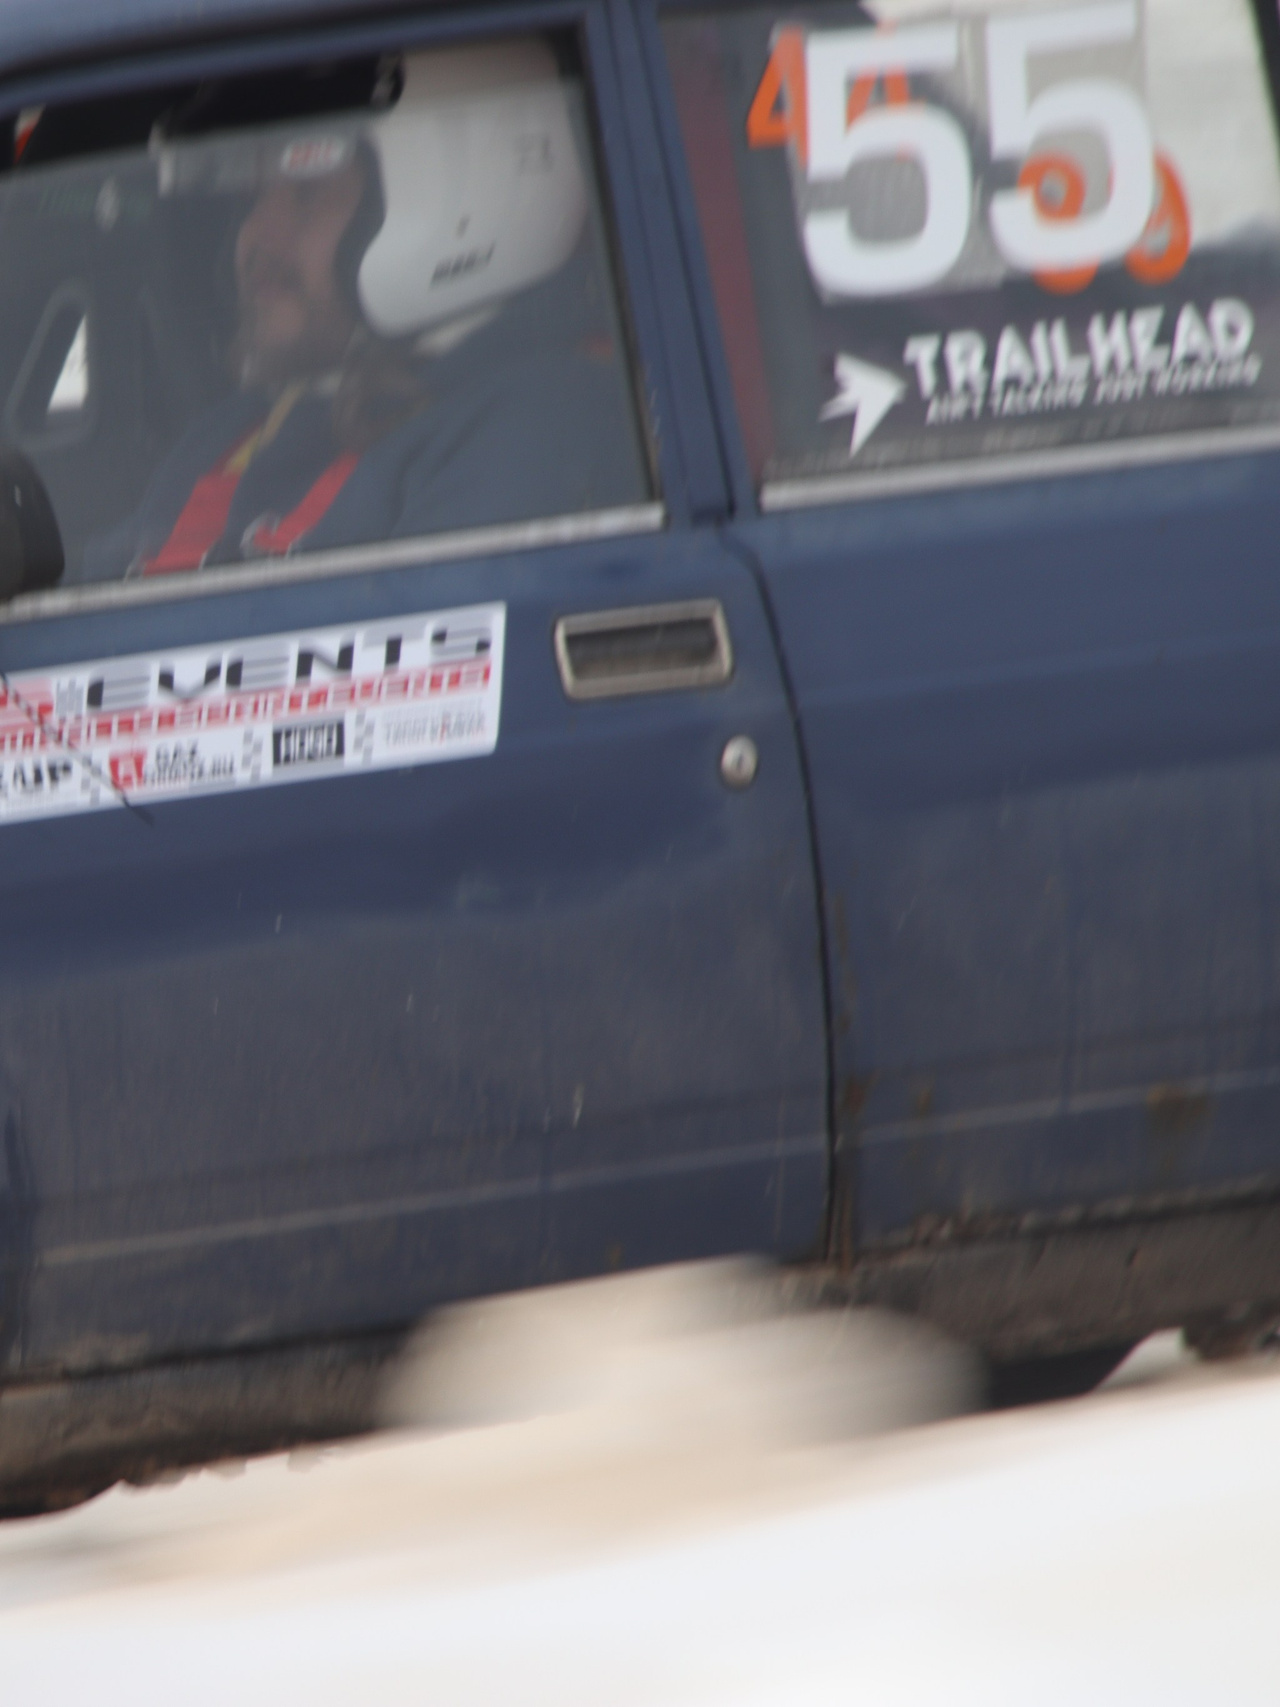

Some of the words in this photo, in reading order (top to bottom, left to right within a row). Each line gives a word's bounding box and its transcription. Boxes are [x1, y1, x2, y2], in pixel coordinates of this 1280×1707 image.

[803, 2, 1153, 298] 55
[904, 297, 1254, 398] TRAILHEAD
[85, 617, 493, 711] EVENTS
